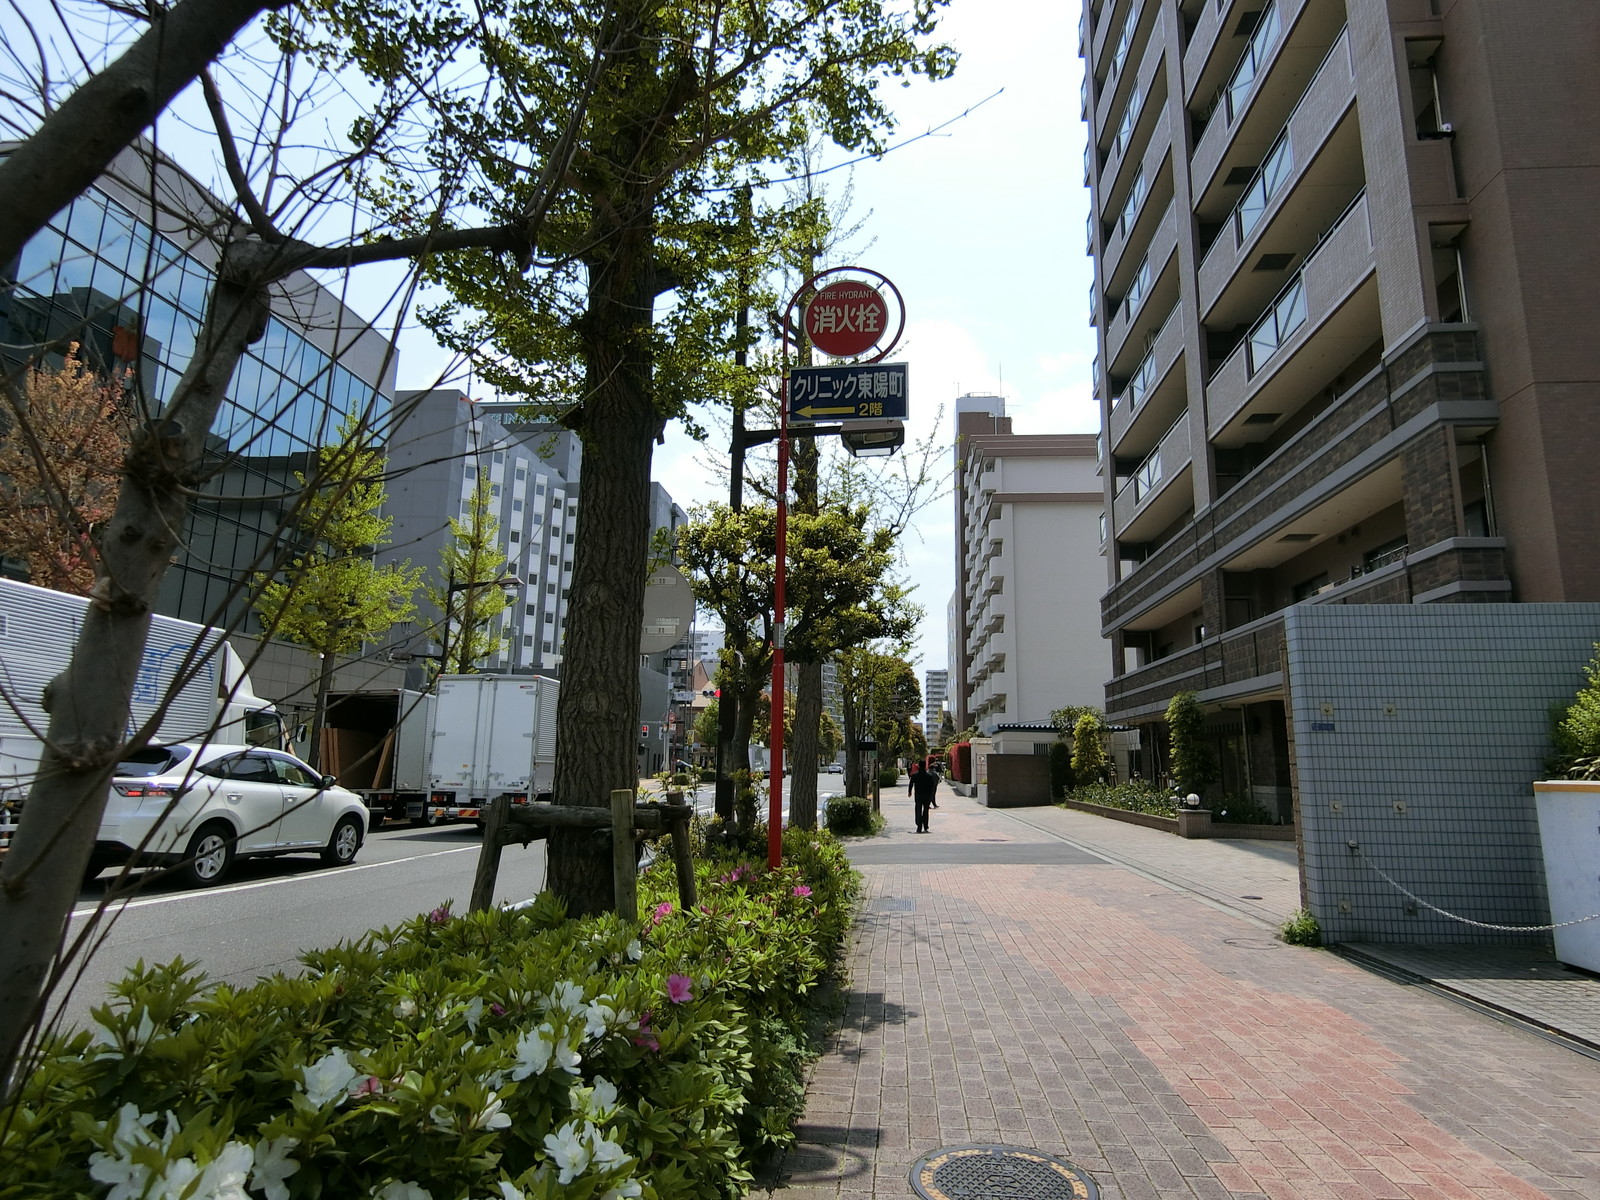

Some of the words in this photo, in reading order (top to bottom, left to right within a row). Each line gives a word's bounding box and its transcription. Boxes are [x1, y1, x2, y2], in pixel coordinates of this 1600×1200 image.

[820, 291, 836, 300] FIRE
[838, 290, 873, 299] HYDRANT
[813, 303, 881, 334] 消火栓
[794, 371, 904, 401] クリニック東陽町
[858, 402, 883, 416] 2階
